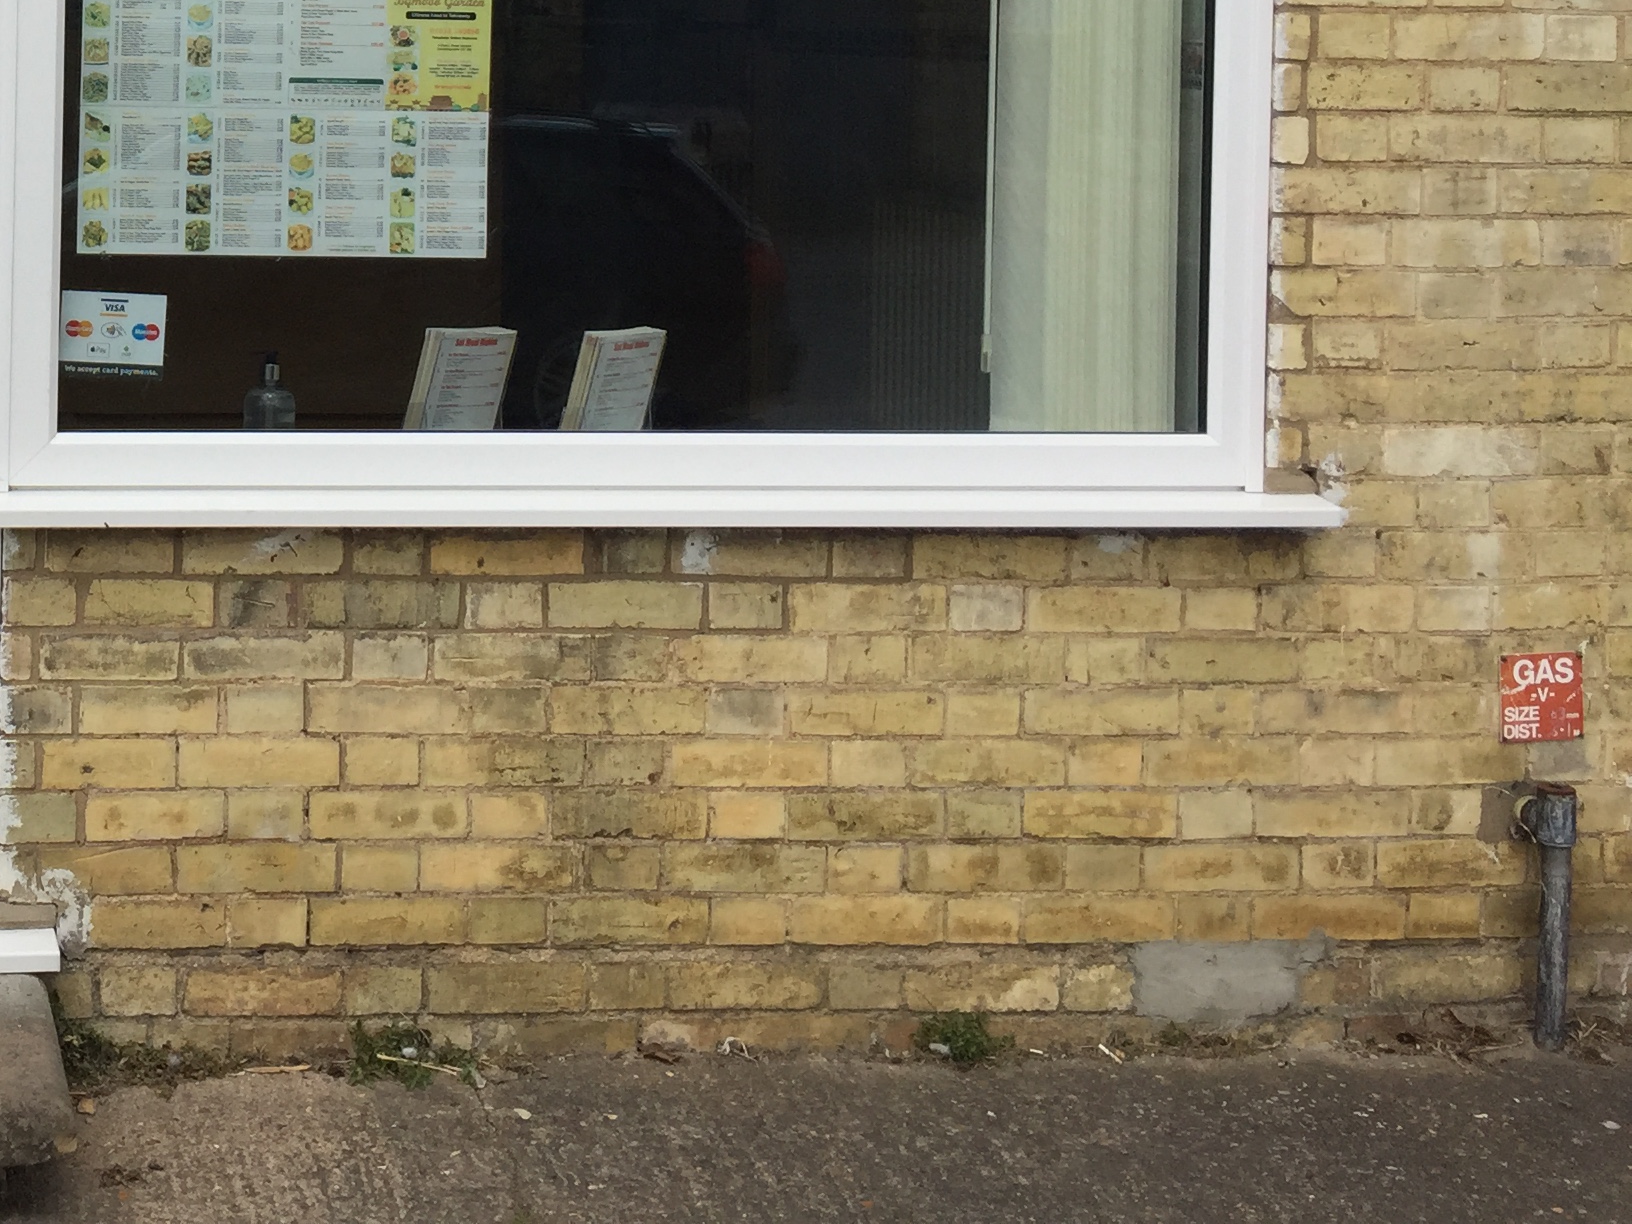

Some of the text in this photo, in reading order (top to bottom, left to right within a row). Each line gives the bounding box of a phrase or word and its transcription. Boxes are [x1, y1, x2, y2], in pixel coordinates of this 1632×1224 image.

[105, 303, 126, 313] VISA
[102, 366, 119, 374] card
[1513, 657, 1575, 685] GAS
[1504, 706, 1541, 722] SIZE
[1503, 723, 1543, 739] DIST.
